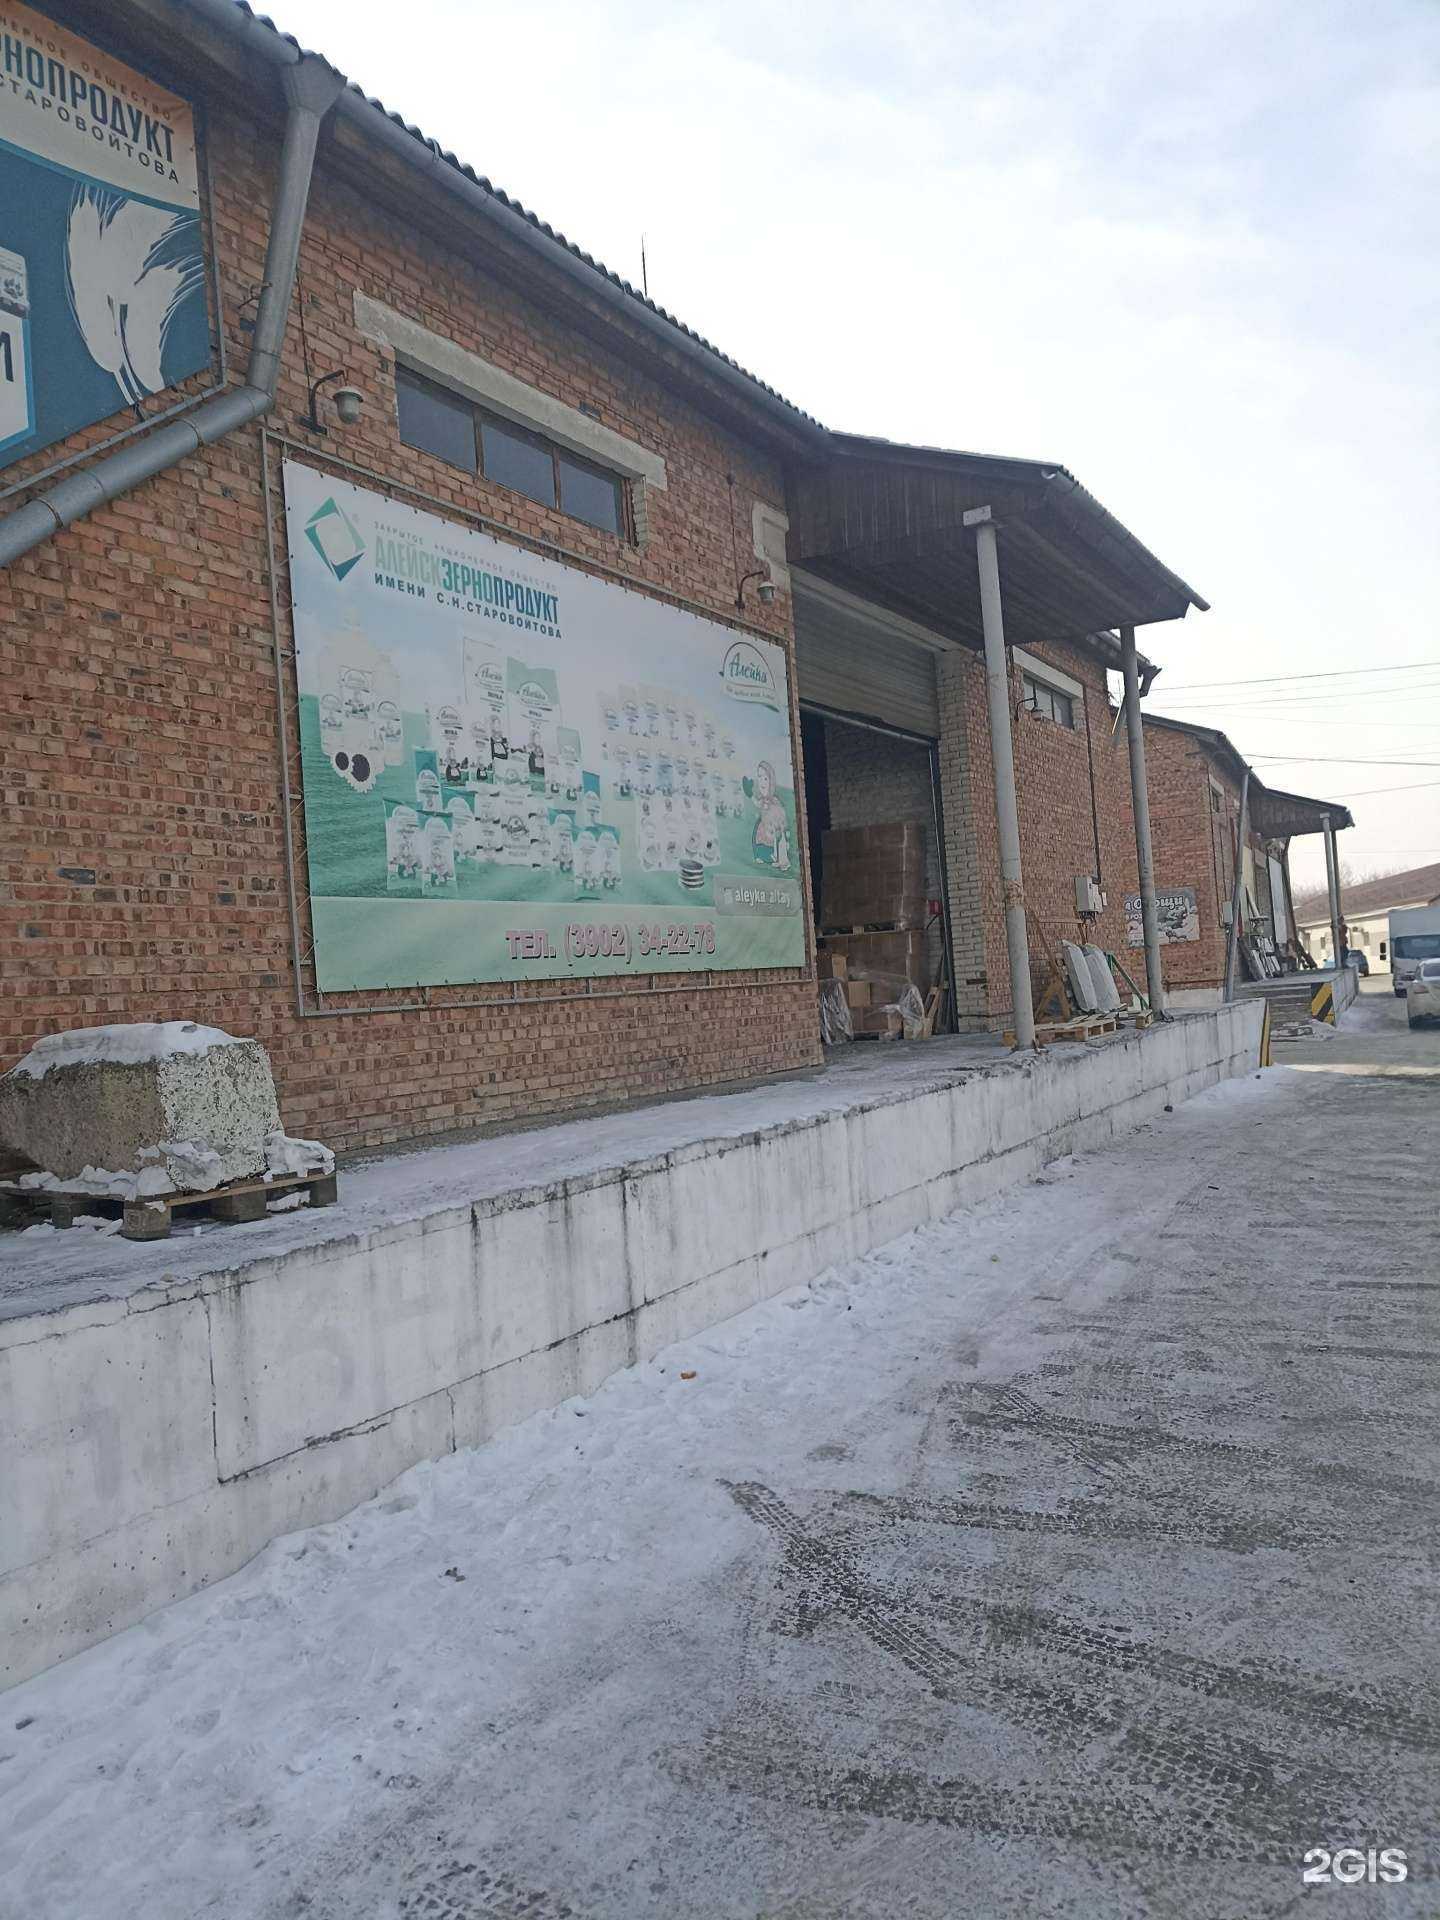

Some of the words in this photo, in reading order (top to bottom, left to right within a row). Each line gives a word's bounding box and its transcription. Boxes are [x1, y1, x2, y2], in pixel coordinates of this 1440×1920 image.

[0, 31, 174, 163] НОПРОДУКТ
[81, 62, 171, 121] ОБЩЕСТВО
[374, 572, 426, 598] ИМЕНИ
[375, 535, 559, 625] АЛЕЙСКЗЕРНОПРОДУКТ
[505, 929, 557, 960] ТЕЛ.
[564, 923, 634, 967] (3902)
[637, 923, 716, 956] 34-22-78
